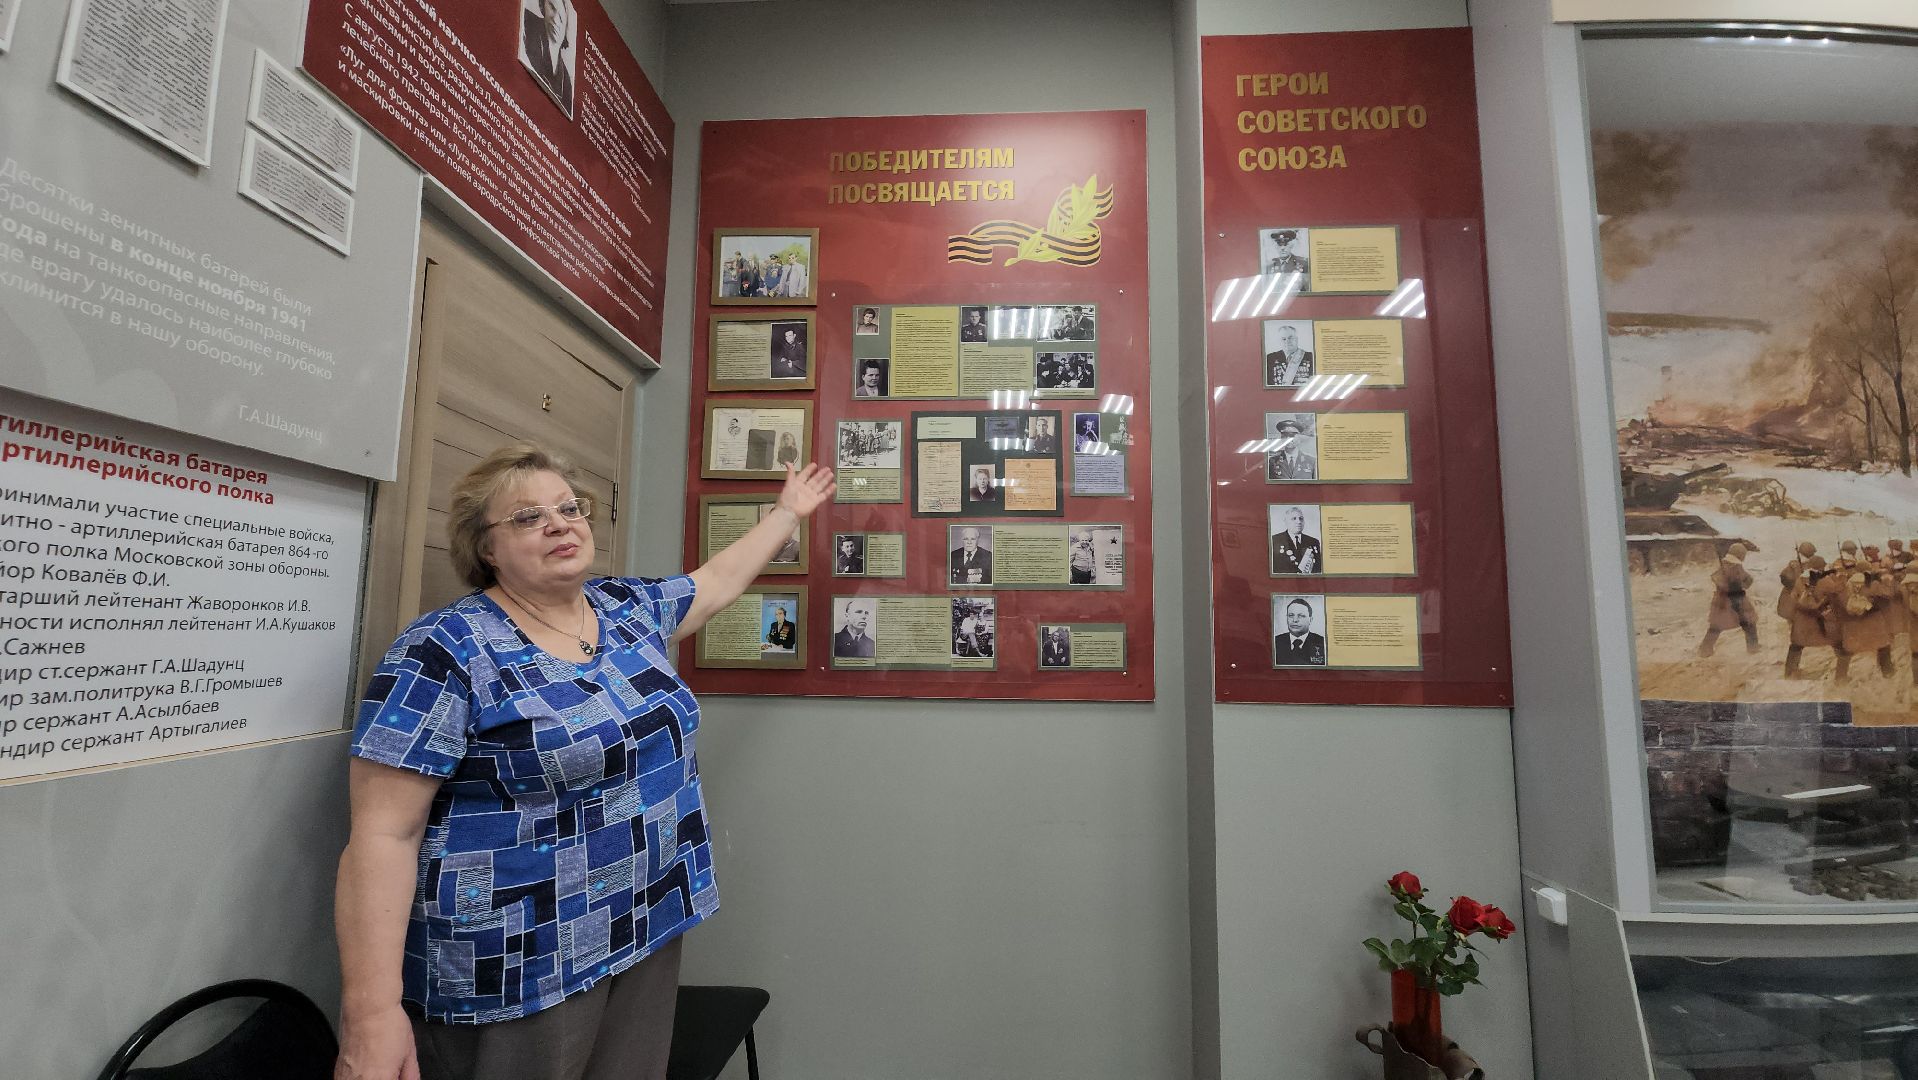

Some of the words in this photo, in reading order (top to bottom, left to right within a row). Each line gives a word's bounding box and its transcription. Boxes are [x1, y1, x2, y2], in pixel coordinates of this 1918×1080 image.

[402, 20, 446, 73] института,
[448, 69, 500, 127] разрушенного
[433, 36, 473, 84] фашистов
[485, 91, 513, 128] Луговой
[1236, 71, 1329, 97] ГЕРОИ
[342, 21, 399, 79] лечебного
[402, 77, 450, 128] препарата.
[453, 122, 466, 142] Вся
[468, 140, 506, 181] продукция
[531, 198, 550, 223] фронт
[355, 14, 393, 57] августа
[397, 53, 418, 81] 1942
[420, 78, 439, 102] года
[448, 105, 486, 146] институте
[488, 142, 505, 165] были
[506, 163, 532, 192] открыты
[418, 53, 467, 109] воронками,
[469, 105, 510, 152] горестному
[439, 18, 558, 157] научно-исследовательский
[560, 153, 588, 189] институт
[1237, 104, 1428, 134] СОВЕТСКОГО
[340, 45, 364, 70] «Луг
[366, 69, 386, 91] для
[389, 87, 428, 127] фронта»
[431, 125, 446, 145] или
[448, 143, 469, 166] «Луга
[503, 191, 531, 222] большая
[349, 70, 411, 130] маскировки
[414, 127, 445, 160] лётных
[447, 156, 471, 182] полей
[473, 179, 515, 221] аэродромов
[830, 147, 1015, 175] ПОБЕДИТЕЛЯМ
[1238, 144, 1348, 172] СОЮЗА
[828, 180, 1015, 207] ПОСВЯЩАЕТСЯ
[0, 157, 94, 215] Десятки
[100, 208, 196, 263] зенитных
[200, 253, 270, 296] батарей
[273, 288, 314, 317] были
[0, 214, 48, 247] ода
[55, 238, 80, 260] на
[87, 252, 230, 321] танкоопасные
[111, 236, 123, 252] в
[129, 246, 194, 283] конце
[198, 274, 267, 316] ноября
[272, 306, 307, 333] 1941
[31, 255, 96, 293] врагу
[100, 281, 183, 324] удалось
[189, 317, 272, 358] наиболее
[275, 350, 332, 381] глубоко
[110, 311, 122, 325] в
[128, 318, 181, 348] нашу
[238, 404, 324, 444] Г.А.Шадунц
[0, 414, 180, 468] тиллерийская
[186, 453, 268, 485] батарея
[2, 441, 211, 494] ртиллерийского
[217, 483, 274, 504] полка
[0, 485, 100, 514] инимали
[105, 503, 179, 524] участие
[184, 515, 286, 538] специальные
[289, 528, 335, 546] войска,
[1, 513, 53, 531] итно
[71, 522, 223, 549] артиллерийская
[0, 538, 40, 554] ого
[46, 544, 108, 562] полка
[114, 547, 223, 570] Московской
[228, 560, 264, 573] зоны
[269, 562, 330, 579] обороны.
[42, 563, 127, 585] Ковалёв
[133, 570, 170, 588] Ф.И.
[84, 592, 185, 609] лейтенант
[187, 595, 284, 613] Жаворонков
[287, 600, 311, 613] И.В.
[0, 616, 63, 630] ности
[69, 618, 163, 631] исполнял
[167, 617, 252, 631] лейтенант
[255, 617, 336, 634] И.А.Кушаков
[0, 667, 33, 684] ир
[38, 663, 148, 681] ст.сержант
[152, 658, 245, 675] Г.А.Шадунц
[29, 683, 175, 706] зам.политрука
[180, 676, 283, 695] В.Г.Громышев
[0, 719, 17, 737] р
[23, 711, 112, 732] сержант
[116, 700, 220, 722] А.Асылбаев
[0, 740, 55, 760] ндир
[61, 730, 145, 752] сержант
[149, 717, 247, 742] Артыгалиев
